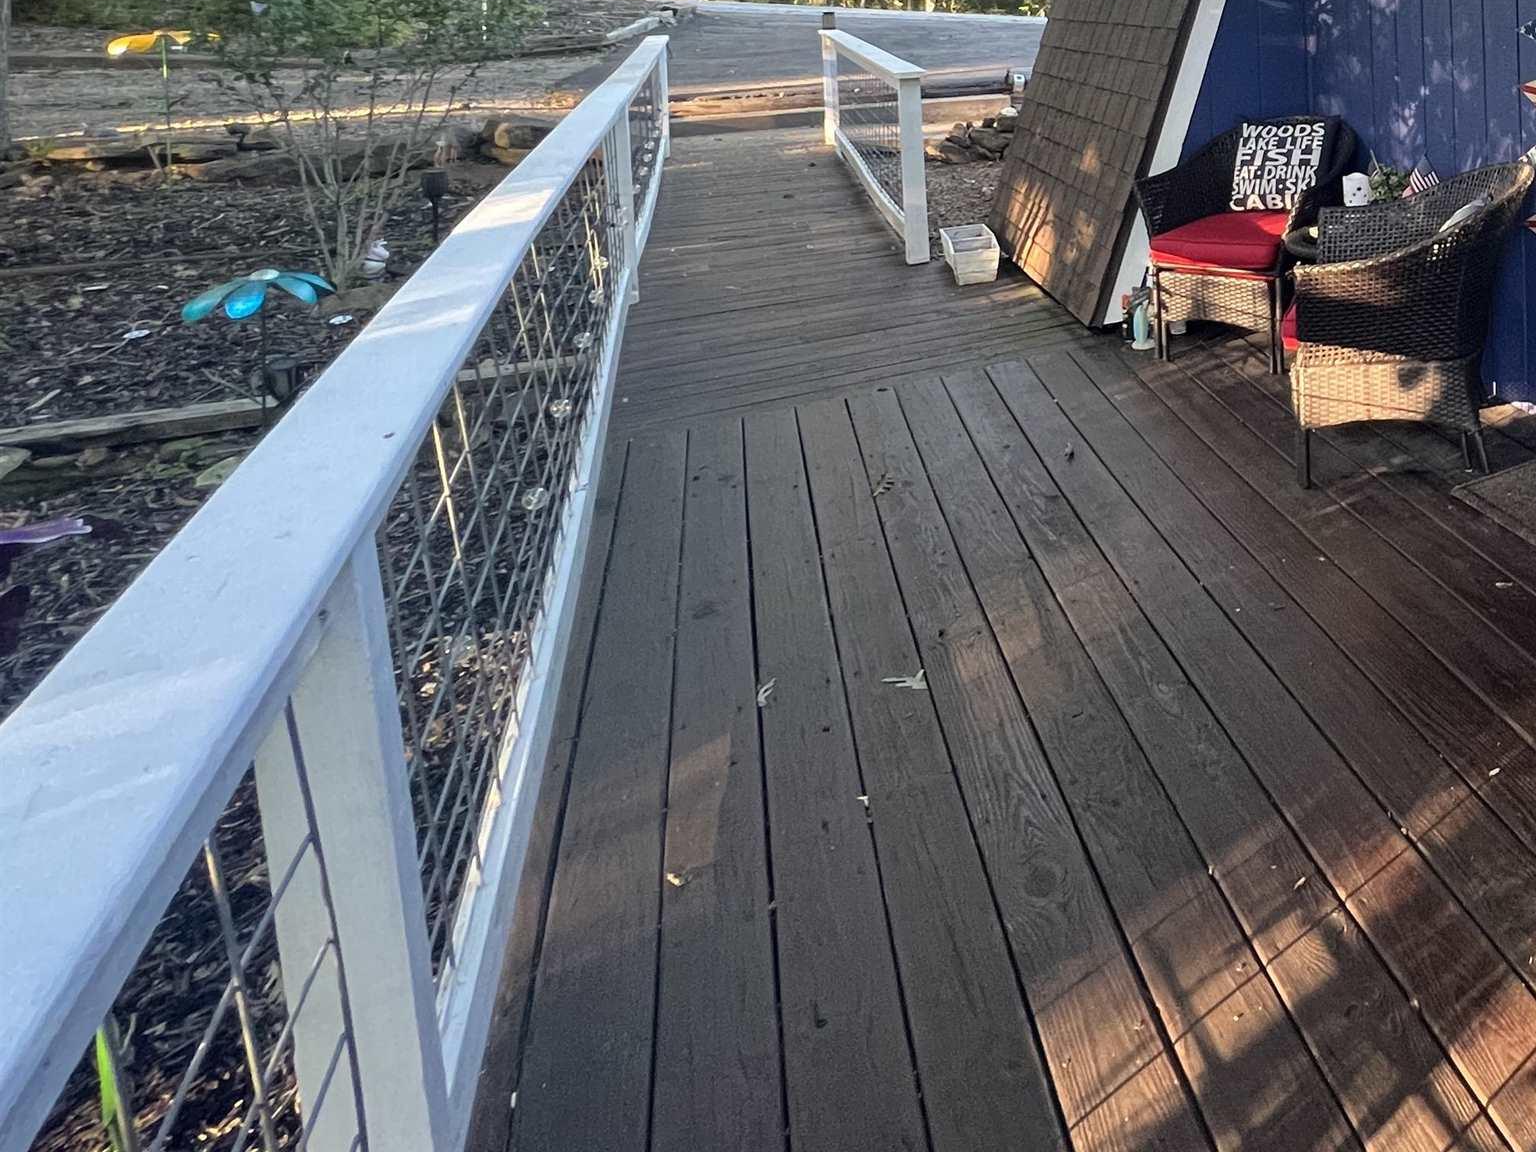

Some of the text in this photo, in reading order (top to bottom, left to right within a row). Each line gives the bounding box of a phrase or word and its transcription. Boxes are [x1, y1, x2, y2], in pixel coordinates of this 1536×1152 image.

[1243, 123, 1324, 138] WOODS
[1240, 136, 1323, 150] LAKE LIFE
[1236, 147, 1321, 166] FISH
[1264, 166, 1318, 180] DRINK
[1229, 194, 1299, 210] CABI
